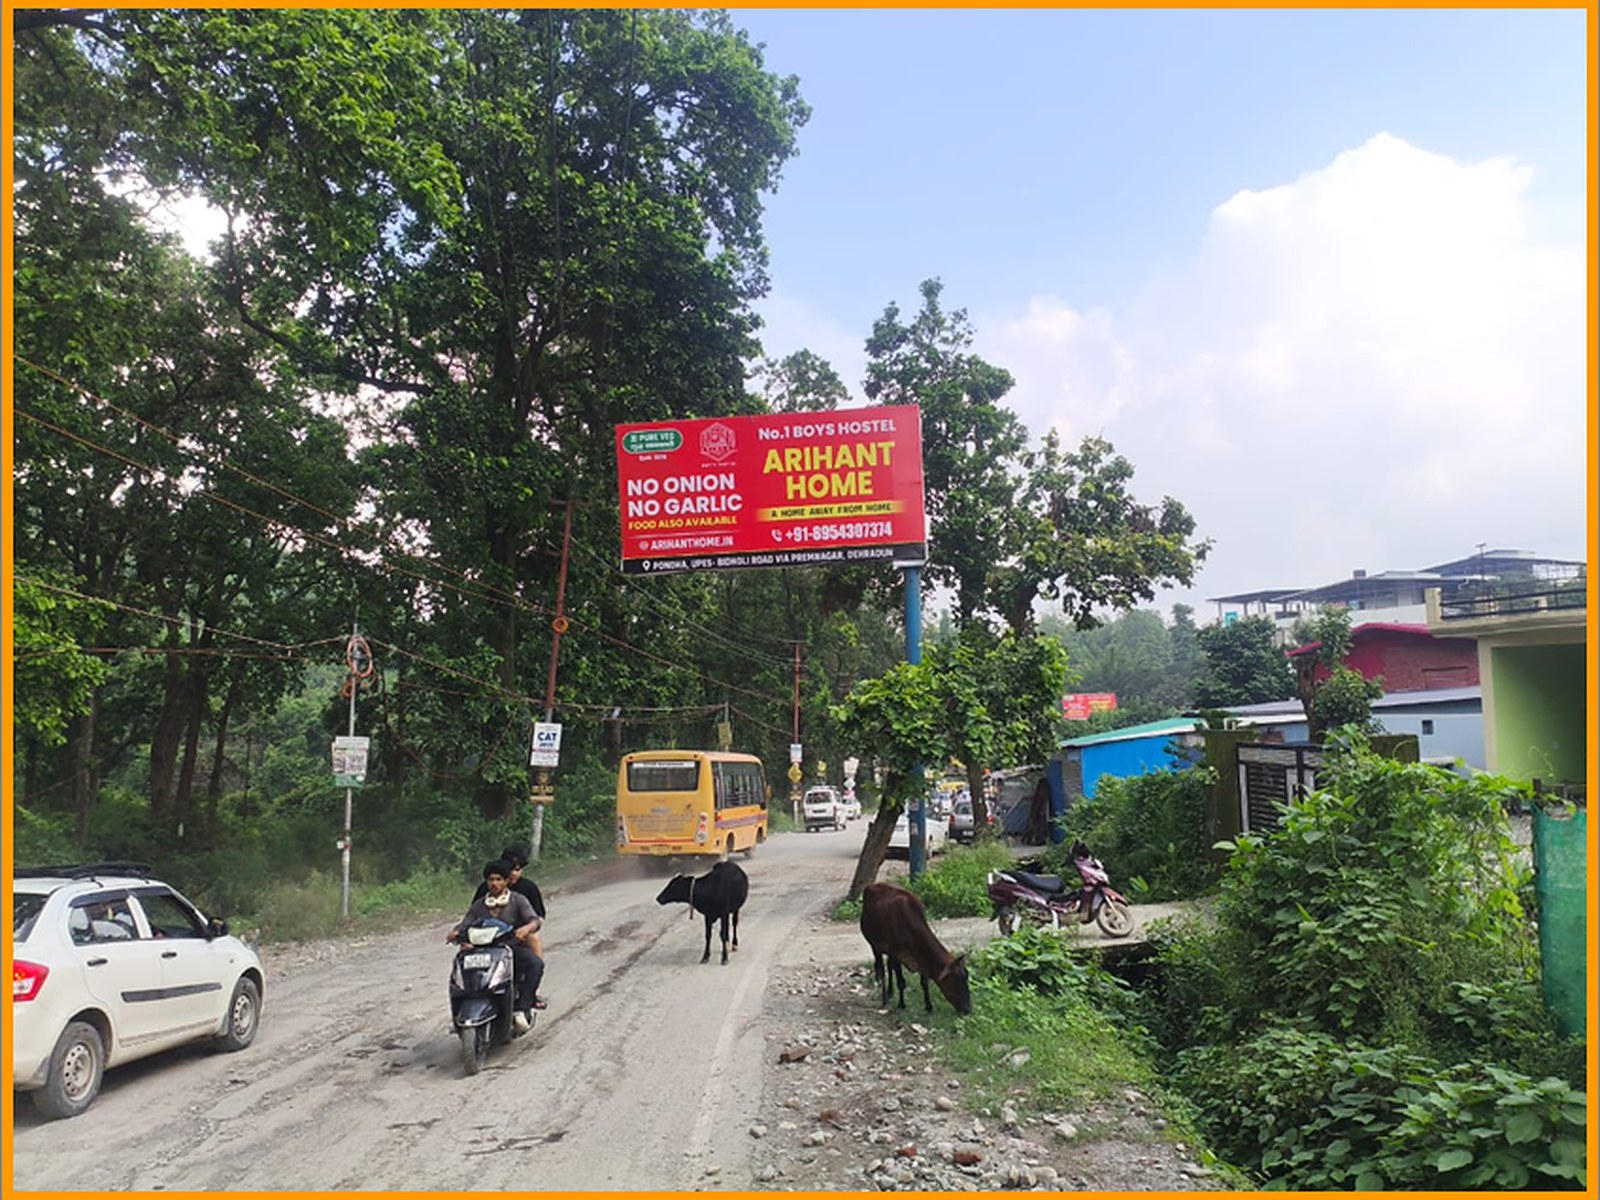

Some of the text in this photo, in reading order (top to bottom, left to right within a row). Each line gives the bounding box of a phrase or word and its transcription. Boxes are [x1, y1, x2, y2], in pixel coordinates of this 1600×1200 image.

[758, 419, 897, 440] No.1 BOYS HOSTEL
[763, 441, 896, 474] ARIHANT
[627, 472, 736, 496] NO ONION
[786, 470, 873, 500] HOME
[627, 493, 743, 518] NO GARLIC
[771, 509, 778, 518] A
[809, 506, 833, 516] AWAY
[837, 504, 863, 513] FROM
[866, 502, 892, 512] HOME
[628, 515, 737, 531] FOOD ALSO AVAILABLE
[650, 535, 734, 551] ARIHANTHOME.IN
[751, 555, 774, 564] ROAD
[775, 553, 790, 563] VIA
[847, 548, 894, 559] DEHRADUN
[537, 732, 557, 742] CAT
